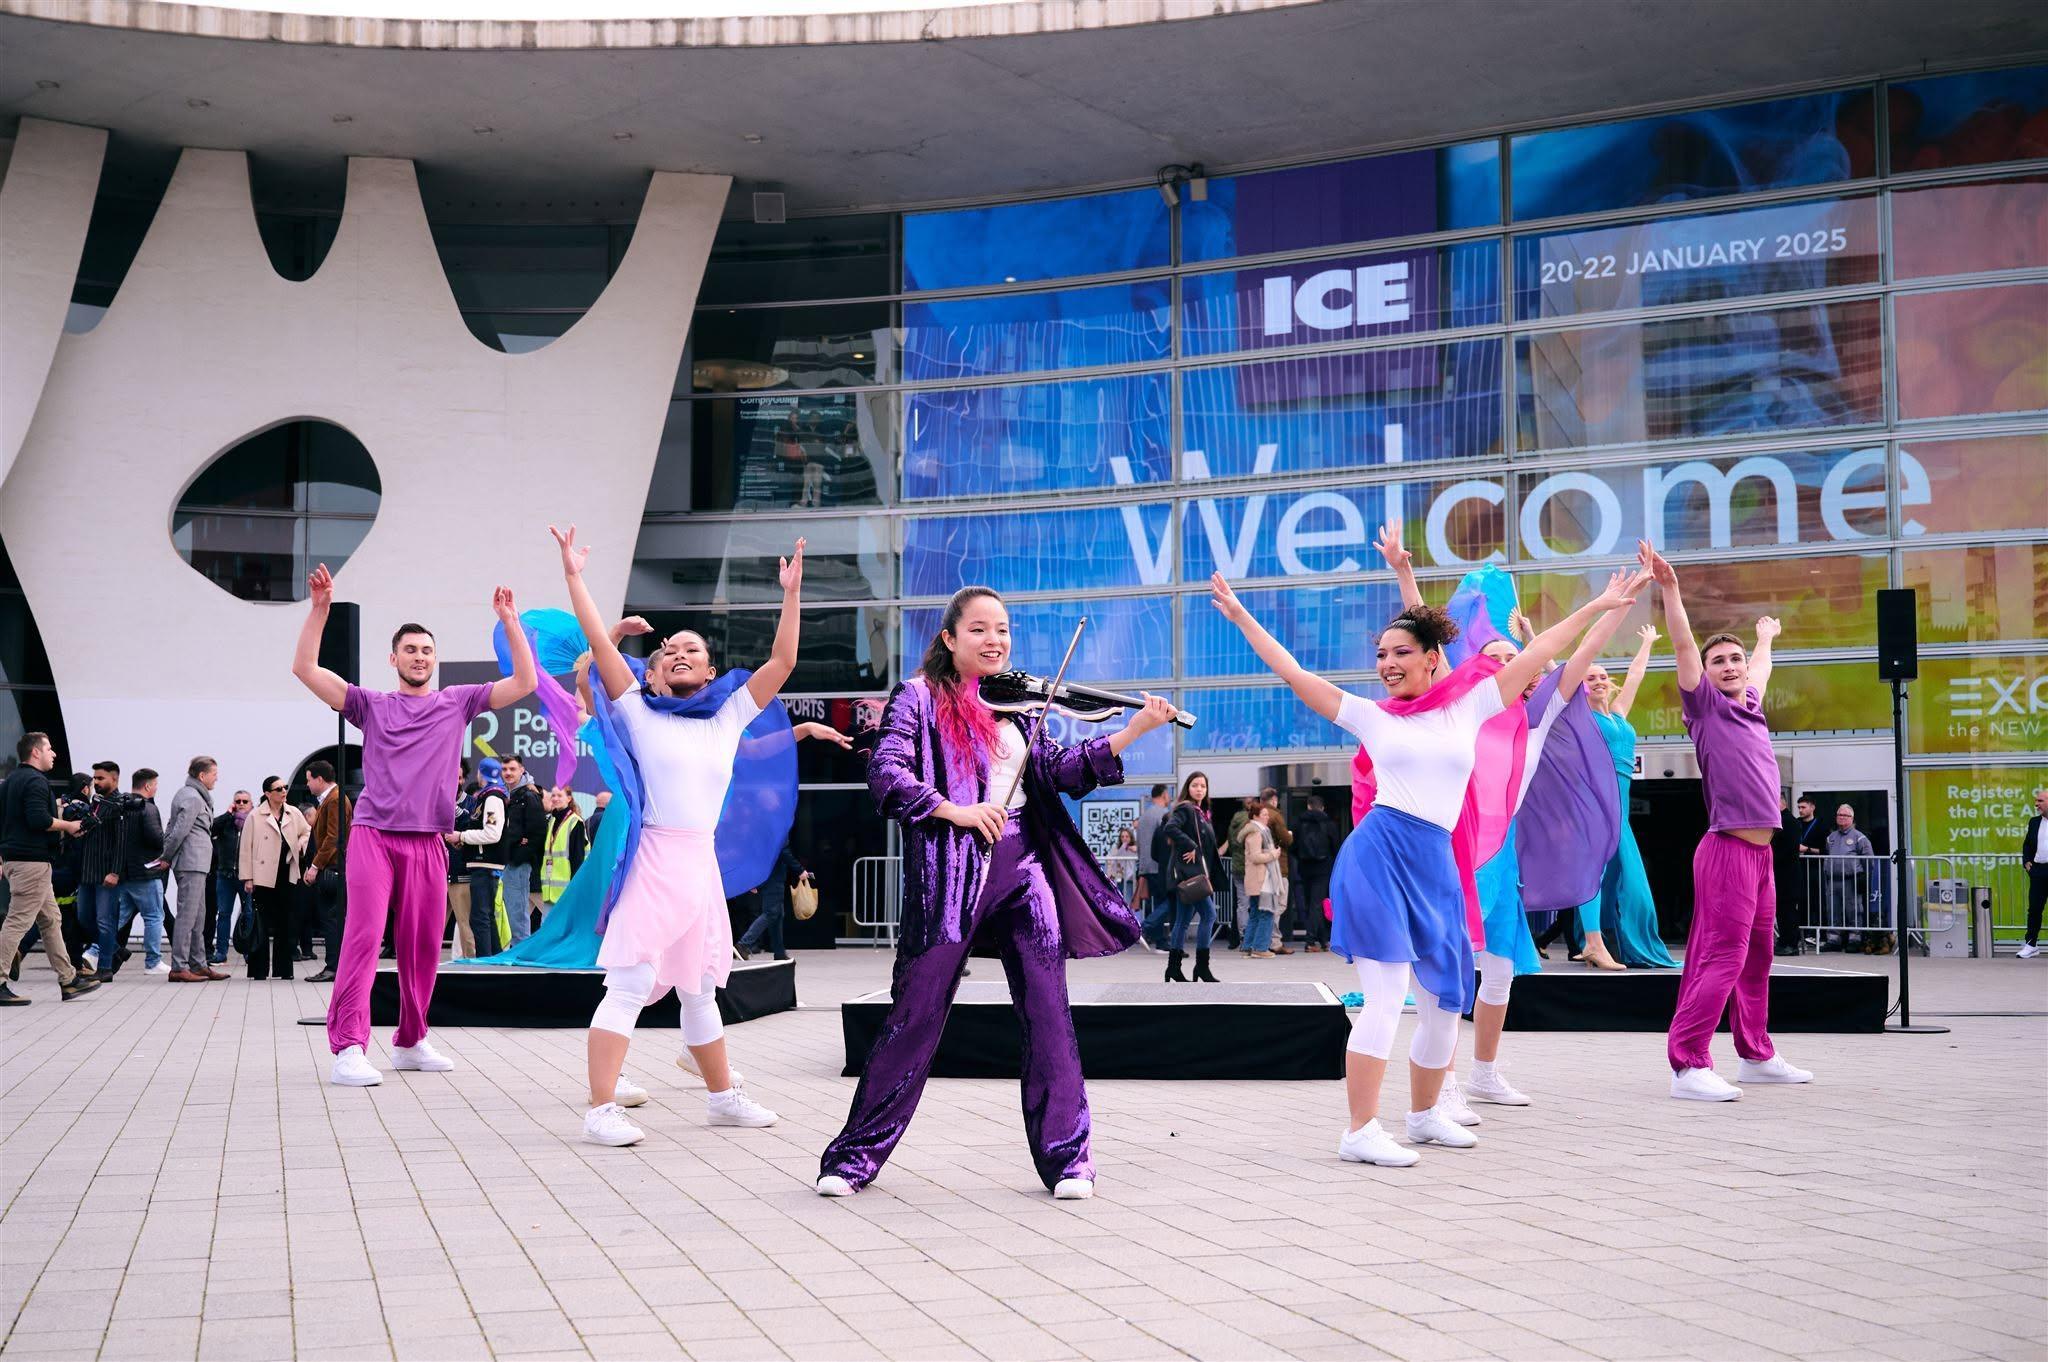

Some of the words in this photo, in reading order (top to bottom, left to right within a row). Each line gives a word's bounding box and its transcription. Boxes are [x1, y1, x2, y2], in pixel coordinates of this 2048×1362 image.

[1541, 255, 1616, 284] 20-22
[1626, 237, 1765, 275] JANUARY
[1775, 228, 1847, 258] 2025
[1264, 262, 1410, 336] ICE
[1110, 424, 1931, 586] Welcome
[784, 698, 825, 719] PORTS
[1948, 722, 1981, 737] the
[1990, 720, 2040, 736] NEW
[1947, 785, 2025, 803] Register,
[1948, 804, 1978, 818] the
[1984, 804, 2013, 818] ICE
[1948, 826, 1990, 841] your
